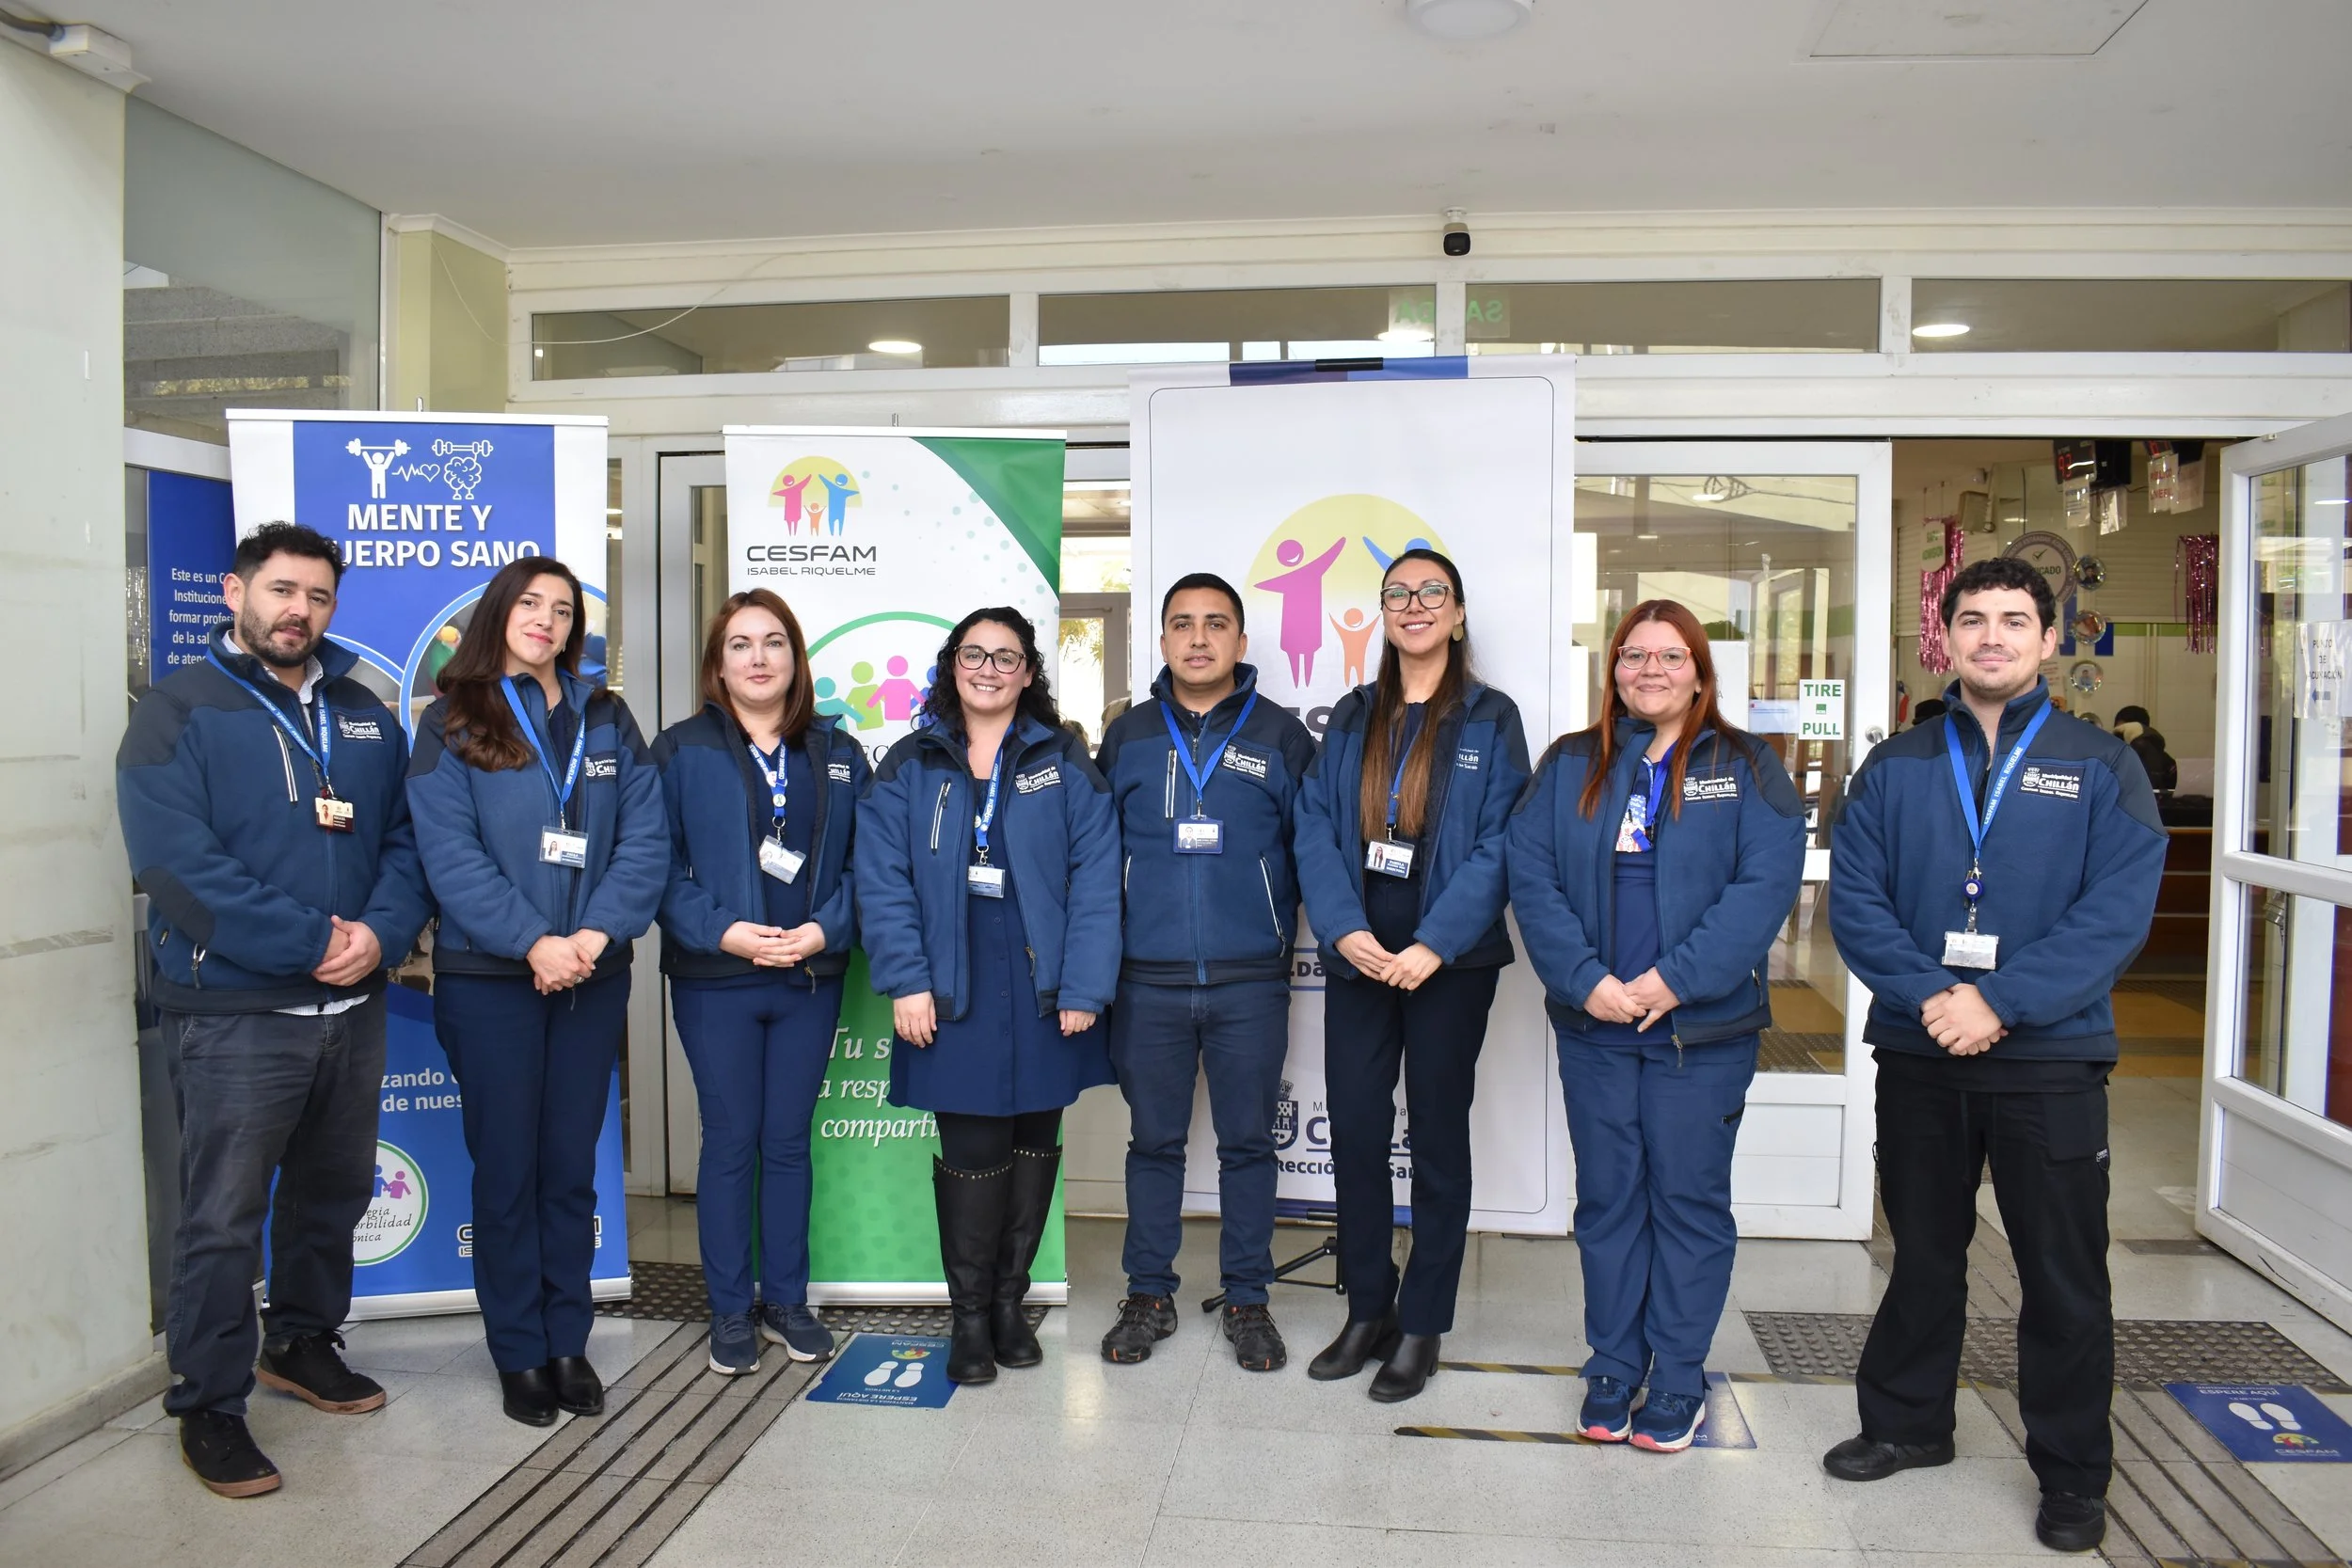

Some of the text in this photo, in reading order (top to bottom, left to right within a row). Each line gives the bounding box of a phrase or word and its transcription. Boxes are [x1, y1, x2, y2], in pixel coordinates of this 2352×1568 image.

[347, 504, 493, 531] MENTE Y
[342, 540, 541, 568] UERPO SANO
[747, 545, 877, 562] CESFAM
[171, 568, 191, 581] Este
[193, 573, 203, 582] es
[205, 574, 217, 583] un
[747, 566, 876, 577] ISABEL RIQUELME
[174, 589, 227, 605] Institucione
[169, 609, 234, 627] formar profesi
[172, 630, 210, 645] de la sal
[167, 651, 180, 664] de
[1804, 684, 1841, 697] TIRE
[1803, 722, 1841, 735] PULL
[596, 765, 616, 774] CHIL
[381, 1068, 445, 1089] zando
[840, 1079, 891, 1108] resp
[381, 1094, 462, 1113] de nues
[820, 1112, 940, 1148] comparti
[354, 1213, 412, 1230] orbilidad
[366, 1207, 390, 1221] egia
[353, 1230, 382, 1243] ónica
[837, 1391, 918, 1402] ESPERE AQUÍ
[2250, 1387, 2280, 1397] AQUÍ
